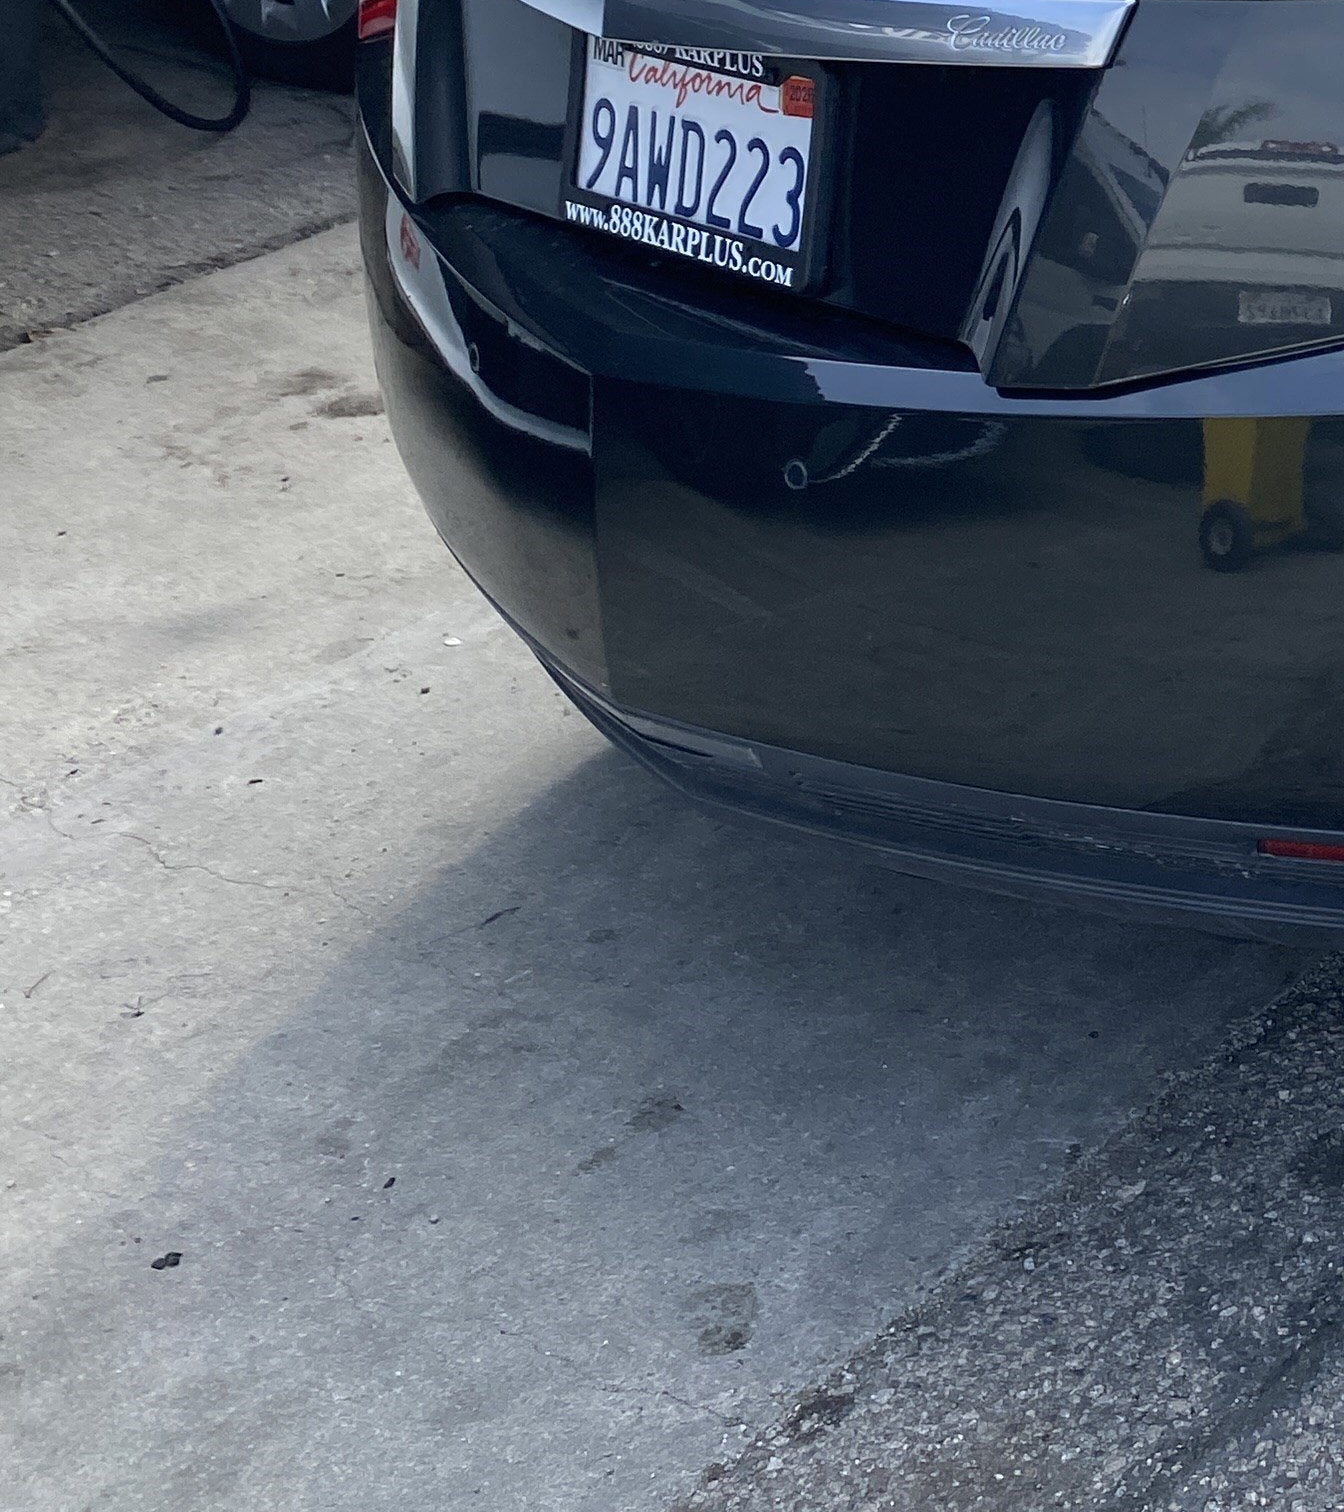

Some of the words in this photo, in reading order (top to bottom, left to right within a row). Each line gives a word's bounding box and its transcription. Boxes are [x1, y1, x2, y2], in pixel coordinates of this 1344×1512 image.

[593, 37, 625, 68] MAR
[947, 14, 1066, 51] Cadillac
[627, 52, 779, 114] California
[586, 98, 805, 248] 9AWD223
